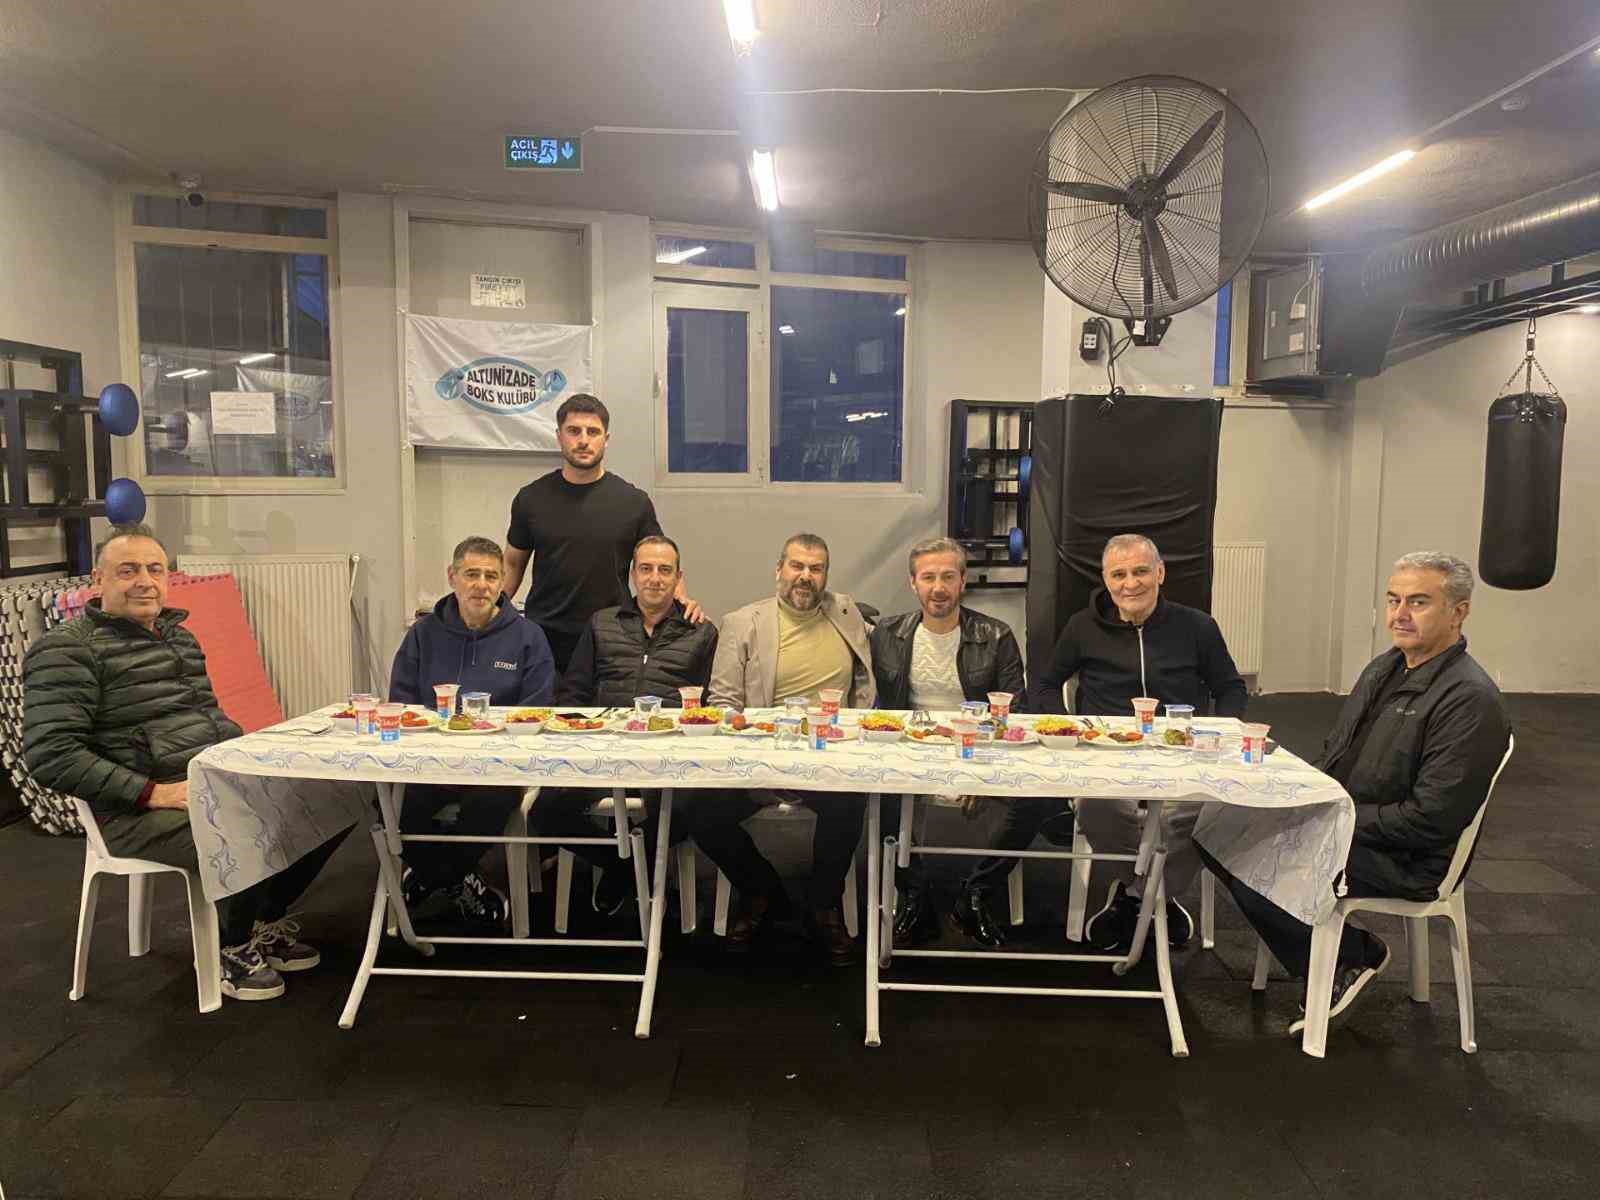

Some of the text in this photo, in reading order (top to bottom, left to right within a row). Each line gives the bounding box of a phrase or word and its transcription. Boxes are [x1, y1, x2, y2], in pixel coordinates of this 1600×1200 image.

[510, 151, 538, 161] ÇIKIŞ
[467, 365, 536, 387] ALTUNİZADE
[467, 384, 536, 405] BOKS KULÜBÜ
